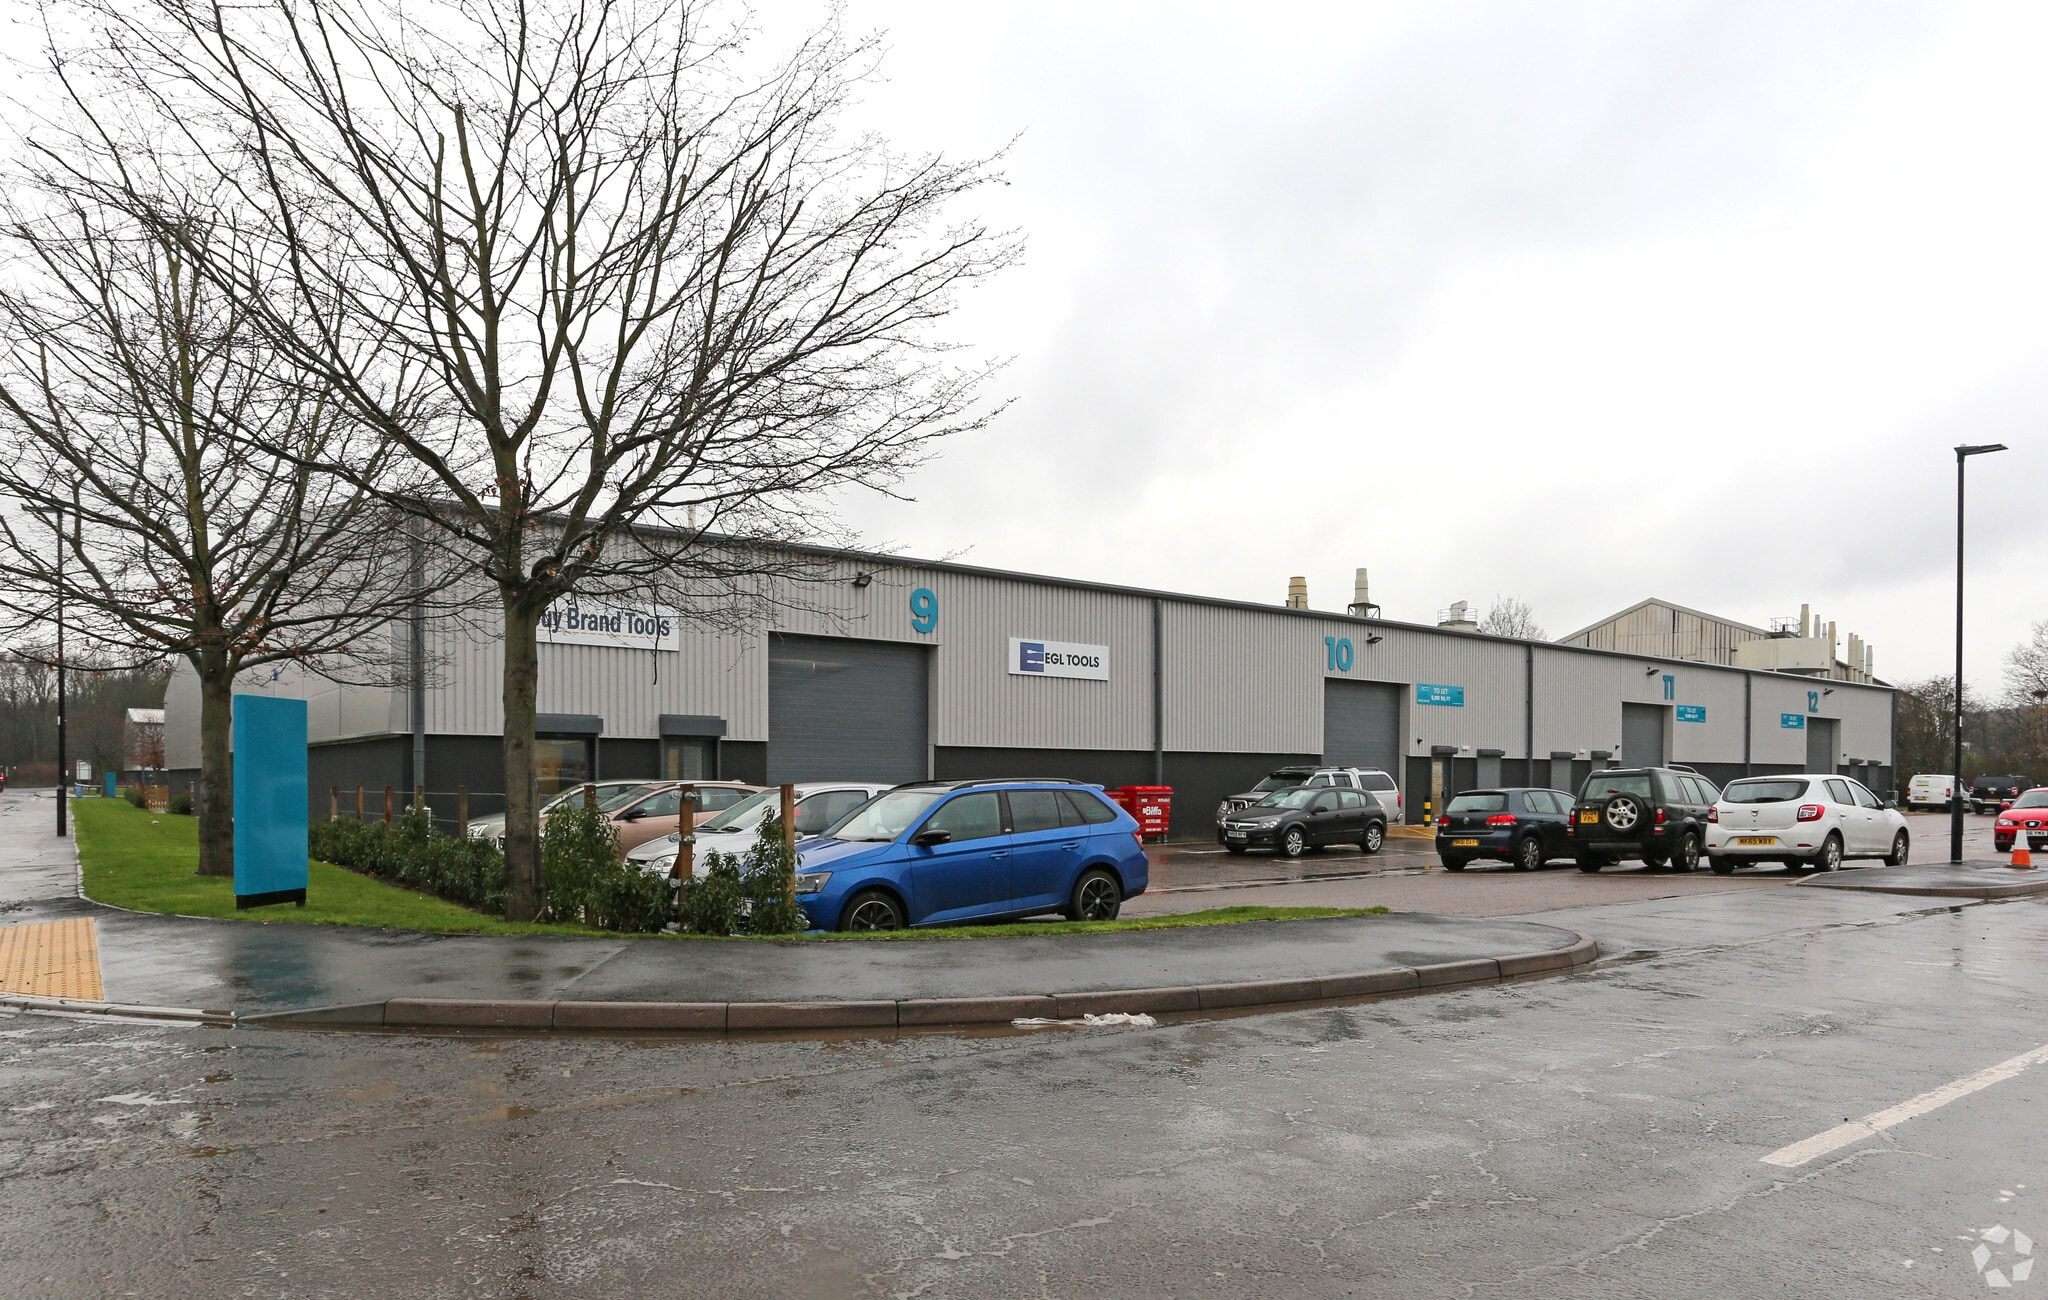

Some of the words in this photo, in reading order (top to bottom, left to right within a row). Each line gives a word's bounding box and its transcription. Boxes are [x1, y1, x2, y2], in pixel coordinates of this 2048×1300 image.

[537, 610, 562, 634] uy
[567, 607, 621, 633] Brand
[625, 612, 671, 637] Tools
[910, 587, 938, 633] 9
[1045, 652, 1064, 666] EGL
[1066, 654, 1100, 668] TOOLS
[1325, 636, 1354, 672] 10
[1662, 674, 1675, 700] 11
[1807, 691, 1819, 713] 12
